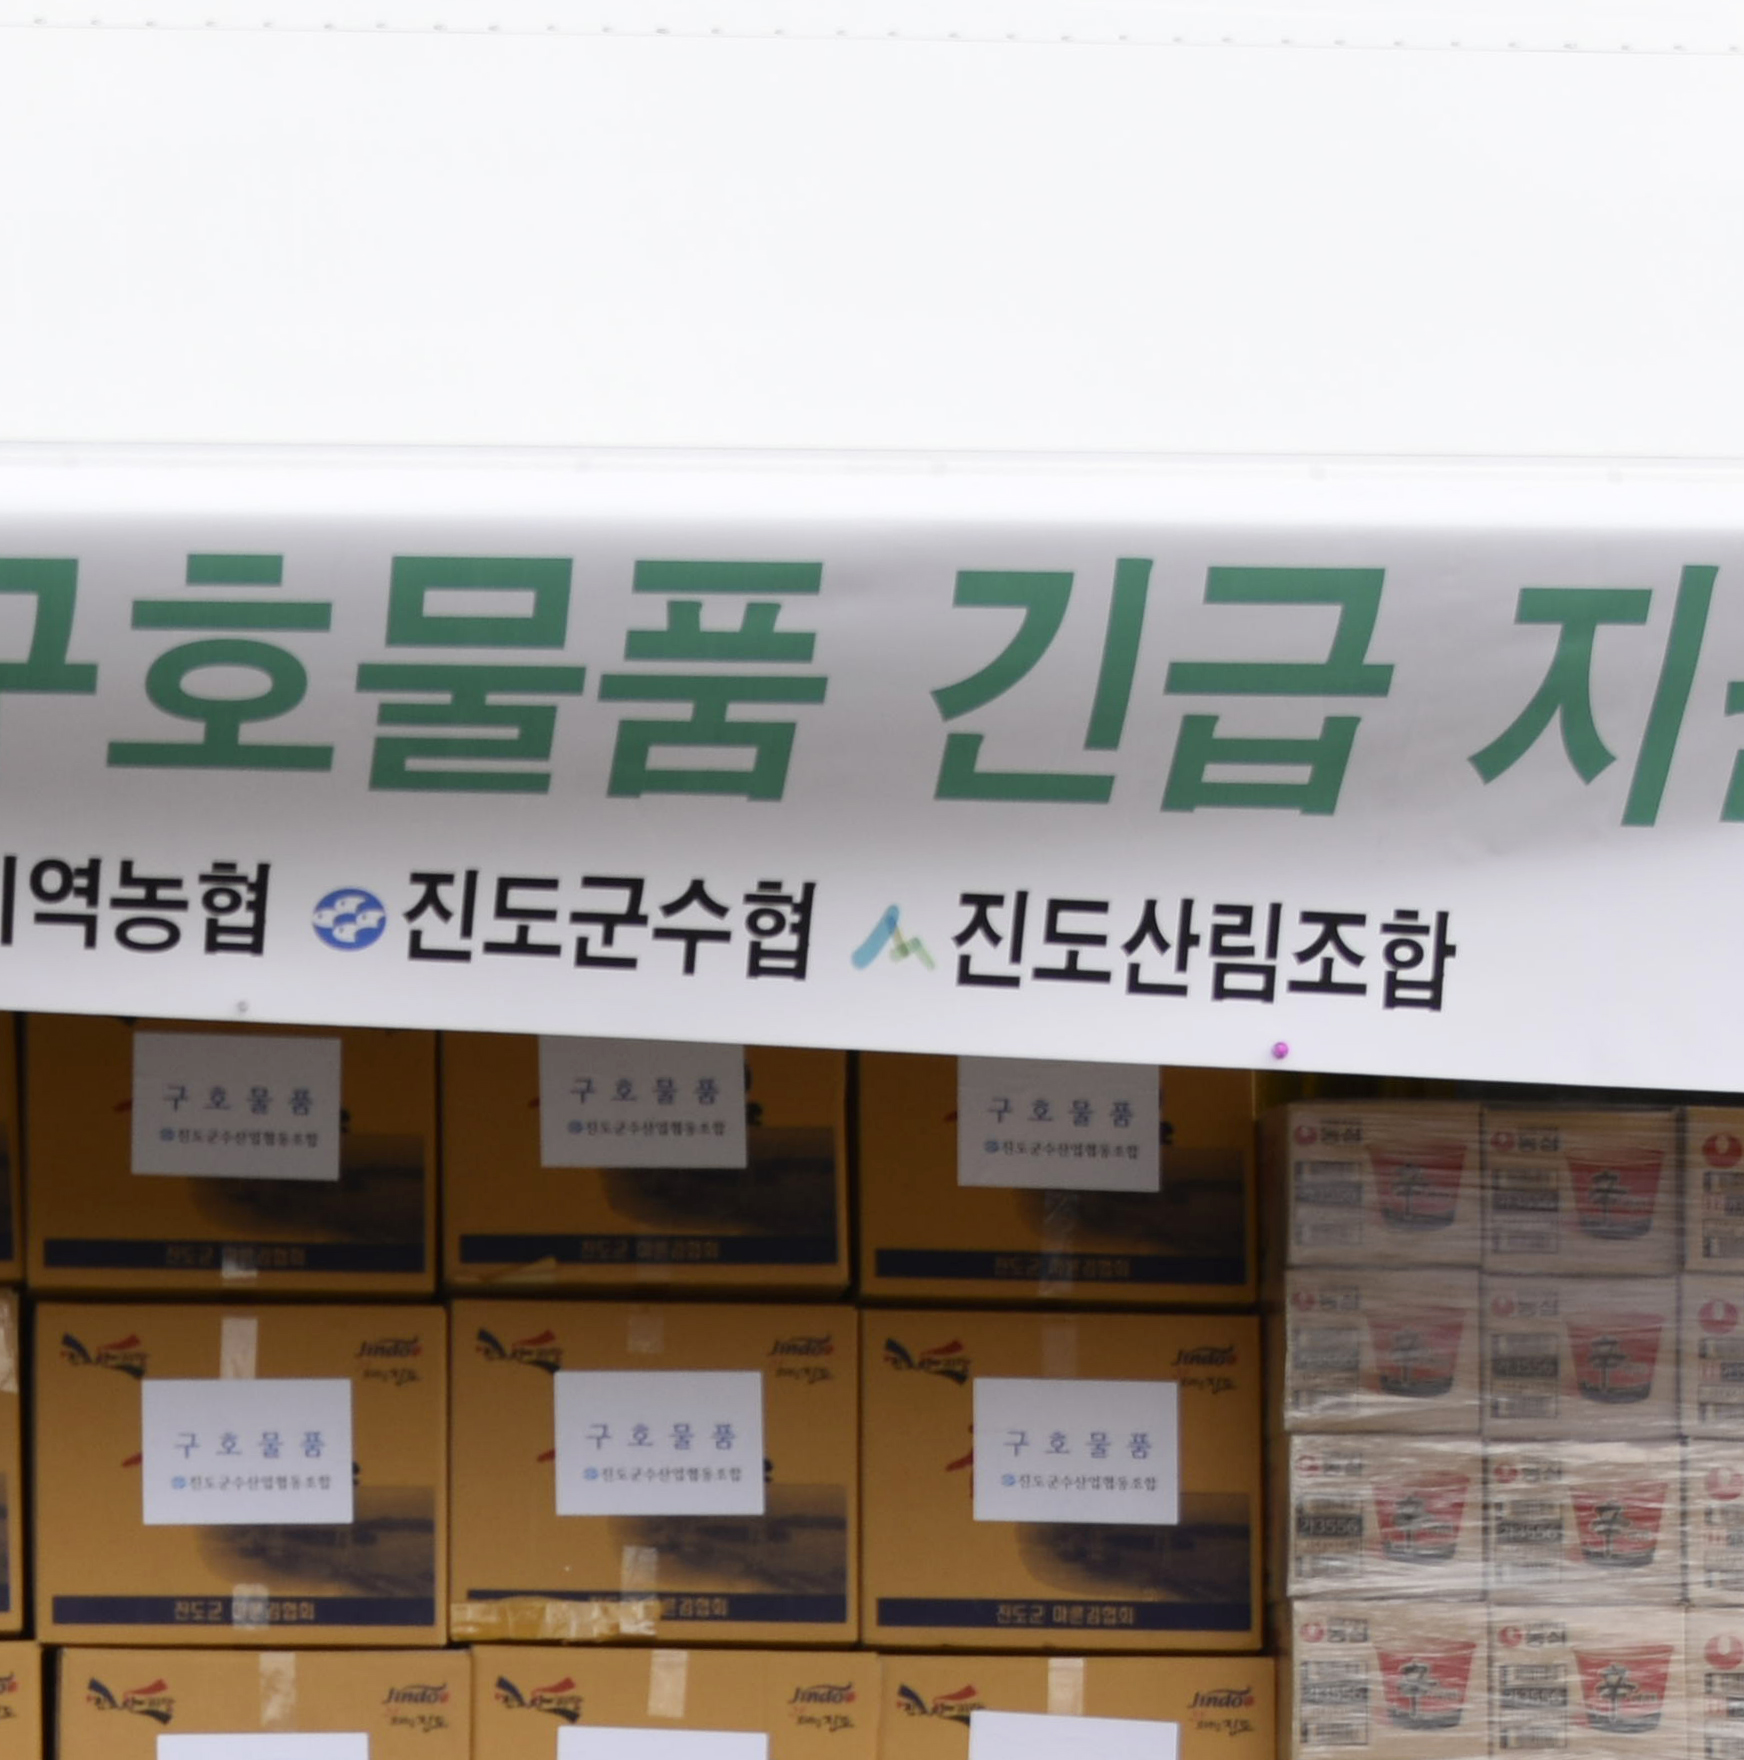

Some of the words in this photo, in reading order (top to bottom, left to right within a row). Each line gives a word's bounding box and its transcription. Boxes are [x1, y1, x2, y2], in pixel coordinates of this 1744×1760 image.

[930, 558, 1395, 815] 긴급
[402, 868, 818, 981] 진도군수협
[951, 889, 1457, 1011] 진도산림조합
